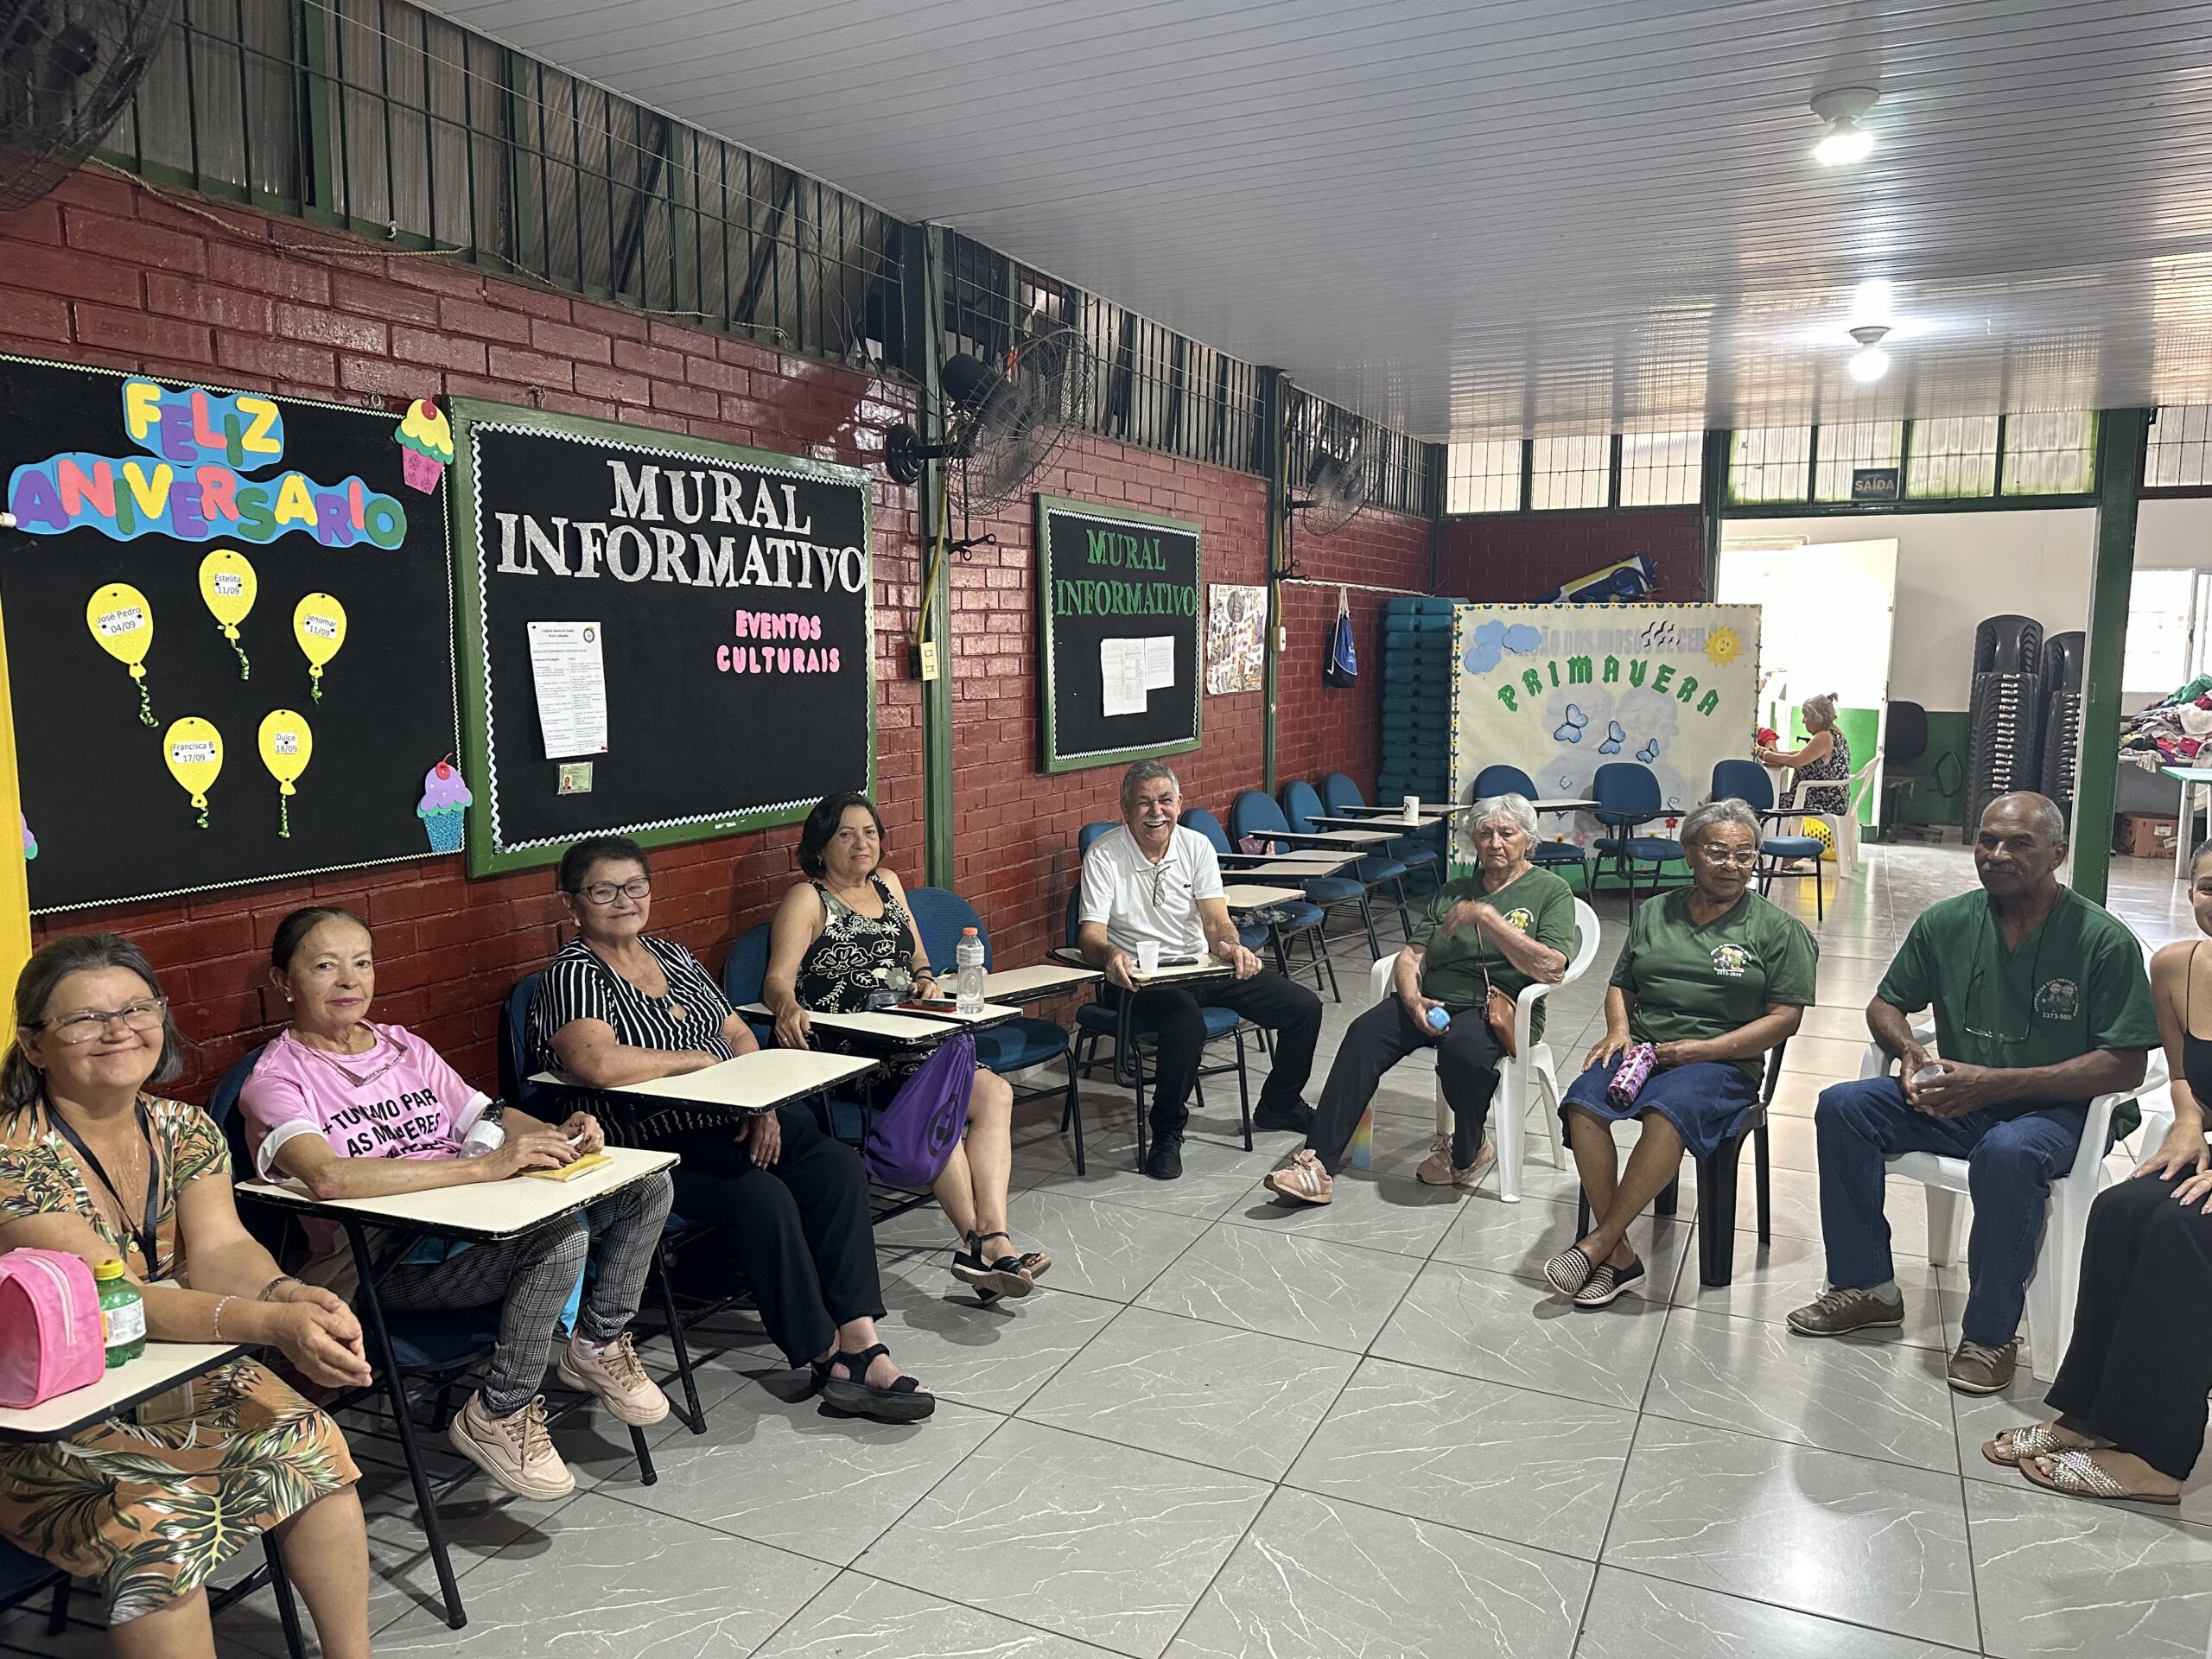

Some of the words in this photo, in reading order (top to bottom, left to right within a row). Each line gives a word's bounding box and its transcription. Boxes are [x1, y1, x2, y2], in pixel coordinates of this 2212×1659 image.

[125, 383, 282, 467] FELIZ
[606, 460, 811, 535] MURAL
[1854, 477, 1894, 491] SAÍDA
[11, 459, 407, 547] ANIVERSARIO
[495, 512, 865, 594] INFORMATIVO
[1086, 529, 1166, 571] MURAL
[214, 574, 241, 583] Estelita
[1055, 579, 1197, 617] INFORMATIVO
[111, 620, 137, 634] 04/09
[117, 607, 142, 621] Pedro
[734, 609, 822, 640] EVENTOS
[309, 625, 331, 637] 11/09
[715, 645, 840, 673] CULTURAIS
[1497, 654, 1719, 716] PRIMAVERA
[183, 753, 206, 763] 17/09
[346, 1132, 373, 1158] AS
